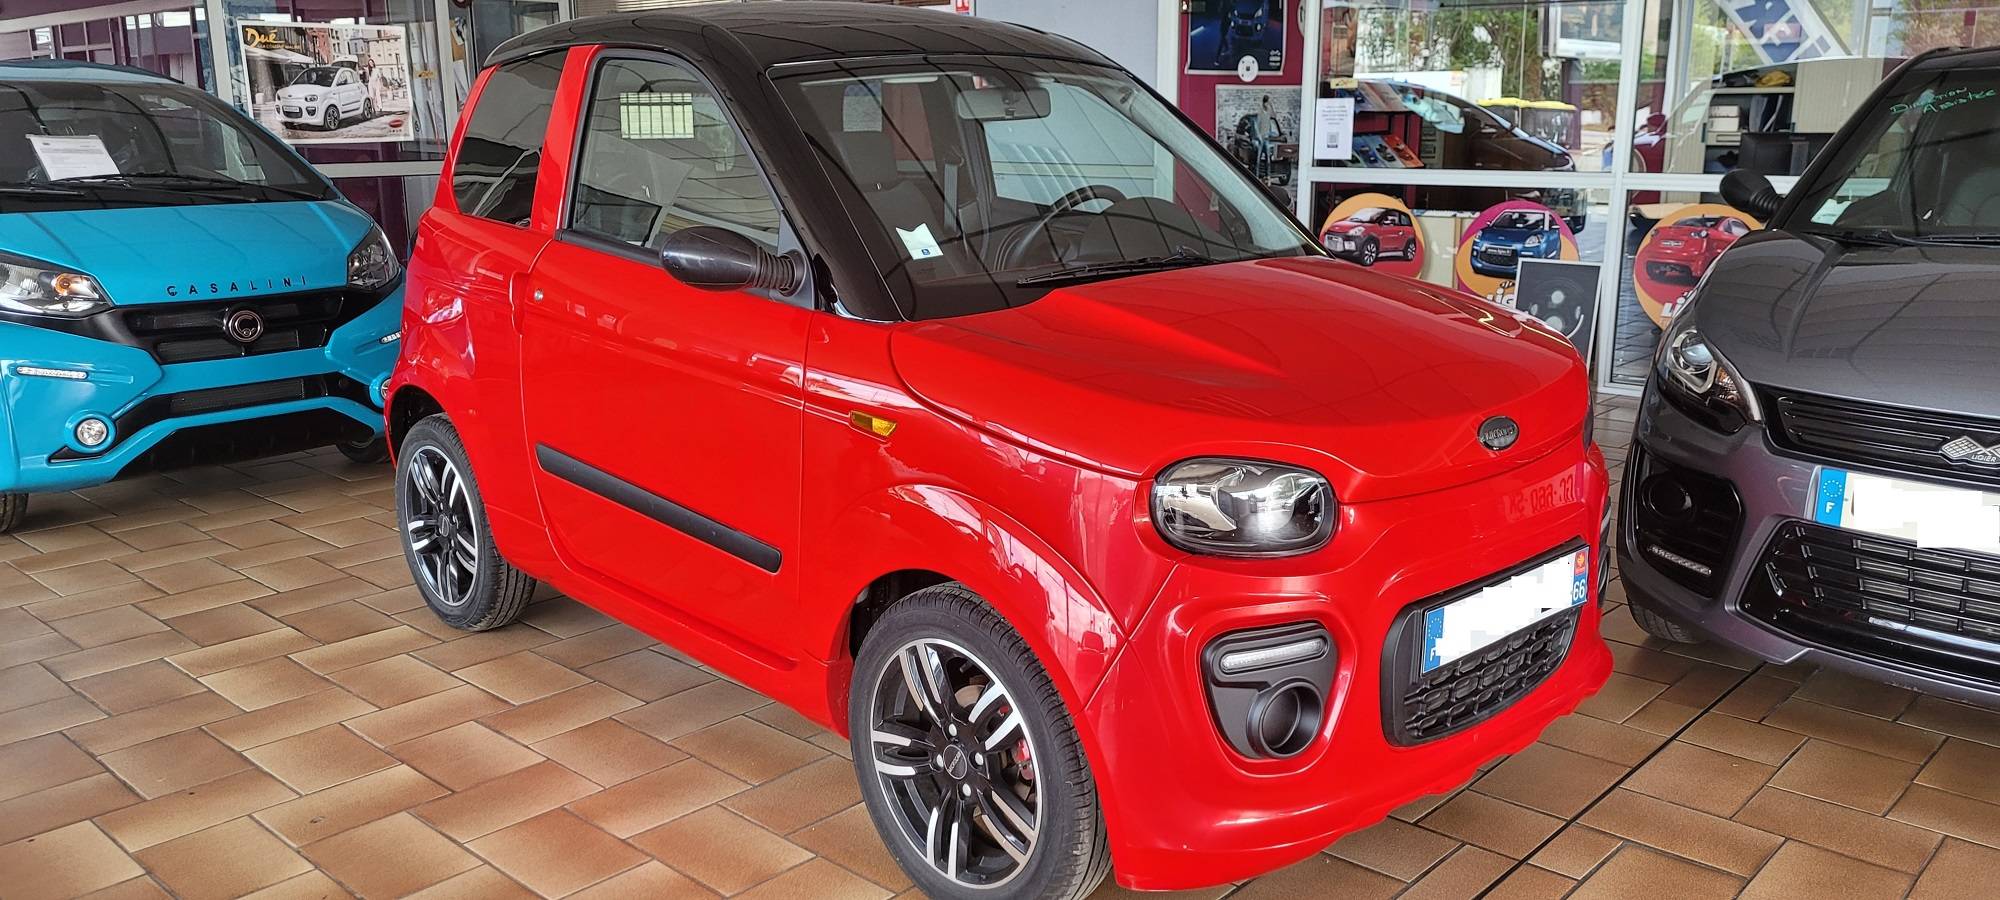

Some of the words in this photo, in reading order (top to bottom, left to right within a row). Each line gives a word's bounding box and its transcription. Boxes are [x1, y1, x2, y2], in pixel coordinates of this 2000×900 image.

[166, 275, 307, 297] CASALINI
[1825, 501, 1836, 514] F
[1573, 579, 1586, 601] 66
